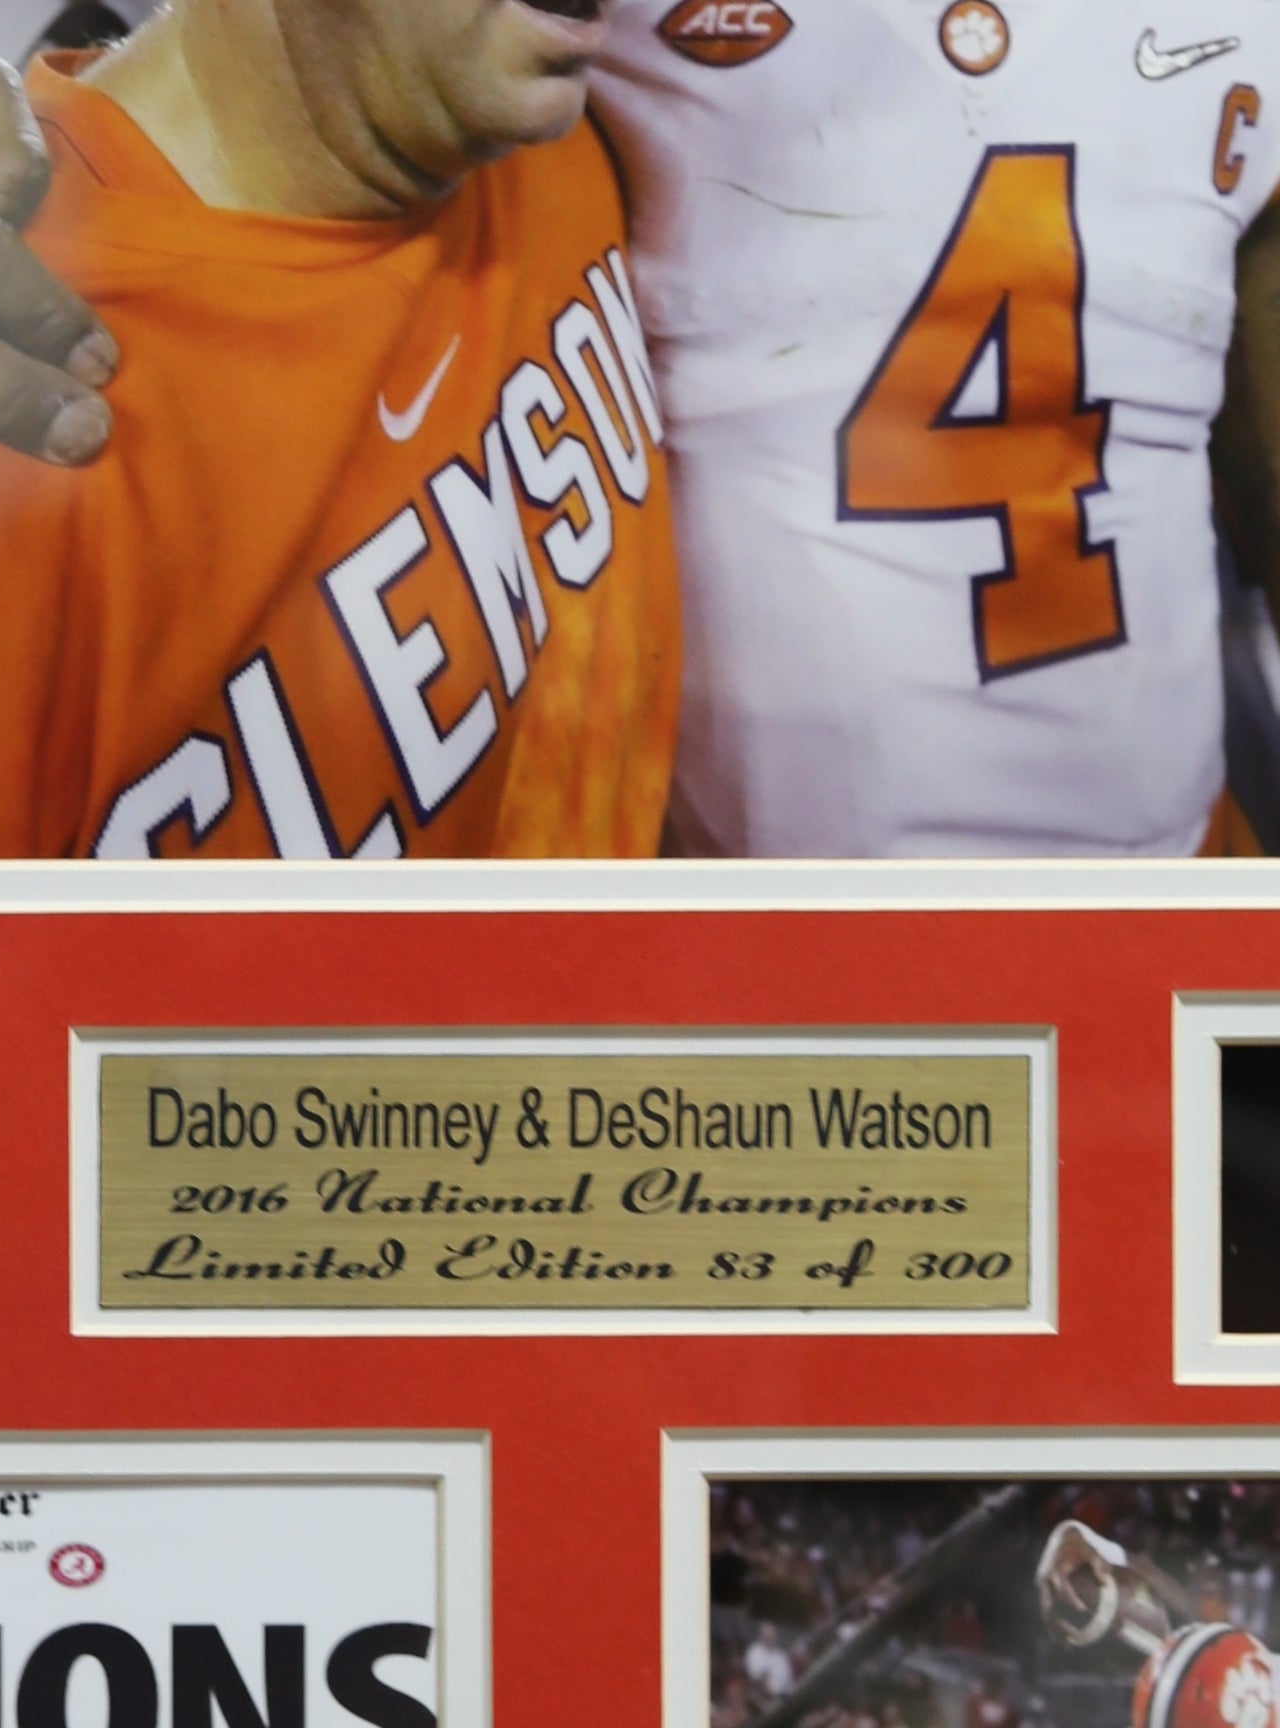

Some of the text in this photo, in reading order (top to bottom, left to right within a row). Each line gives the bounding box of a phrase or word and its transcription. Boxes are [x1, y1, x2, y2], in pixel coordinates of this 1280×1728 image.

[681, 3, 775, 35] ACC
[1211, 83, 1261, 195] C
[835, 141, 1128, 684] 4
[148, 1085, 992, 1164] Dabo Swinney & DeShaun Watson
[170, 1166, 970, 1223] 2016 National Champions
[122, 1234, 1014, 1289] Limited Edition 83 of 300
